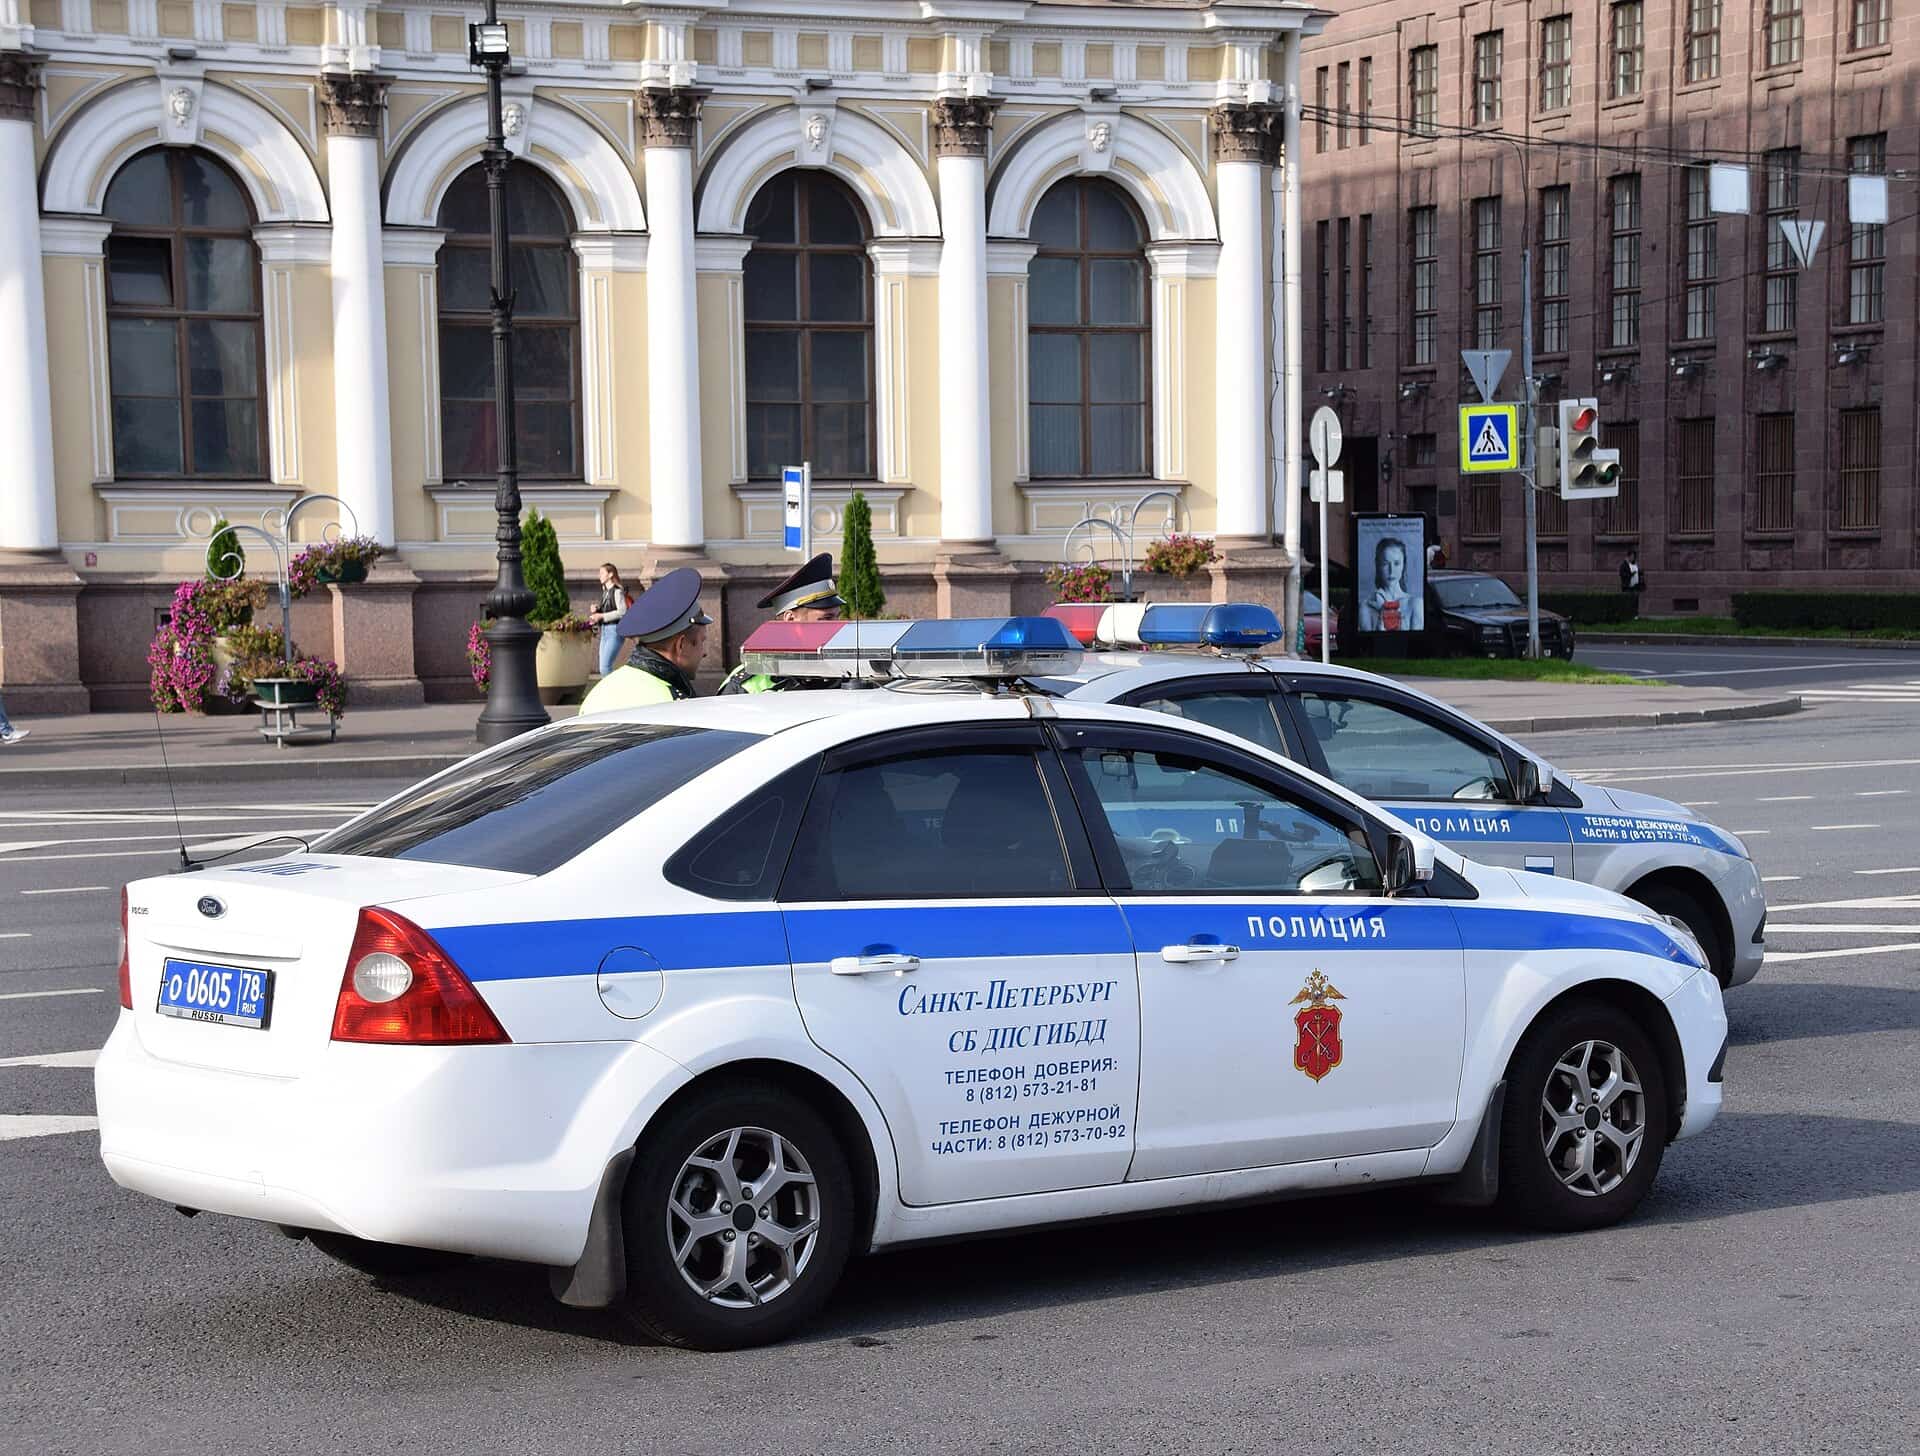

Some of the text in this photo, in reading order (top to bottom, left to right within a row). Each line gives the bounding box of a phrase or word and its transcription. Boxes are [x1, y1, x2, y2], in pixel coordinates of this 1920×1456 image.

[1415, 818, 1511, 835] ПОЛИЦИЯ
[1581, 827, 1619, 839] ЧАСТИ:
[1621, 832, 1628, 840] 8
[1629, 830, 1656, 841] (812)
[1584, 816, 1633, 829] ТЕЛЕФОН
[1247, 916, 1386, 942] ПОЛИЦИЯ
[186, 968, 233, 1009] 0605
[242, 973, 261, 1002] 78
[191, 1010, 224, 1023] RUSSIA
[241, 1002, 257, 1014] RUS
[949, 1018, 1108, 1055] СБ ДПС ГИБДД
[944, 1057, 1119, 1085] ТЕЛЕФОН ДОВЕРИЯ:
[966, 1077, 1098, 1105] 8 (812) 573-21-81
[939, 1103, 1121, 1136] ТЕЛЕФОН ДЕЖУРНОЙ
[931, 1124, 1127, 1156] ЧАСТИ: 8 (812) 573-70-92
